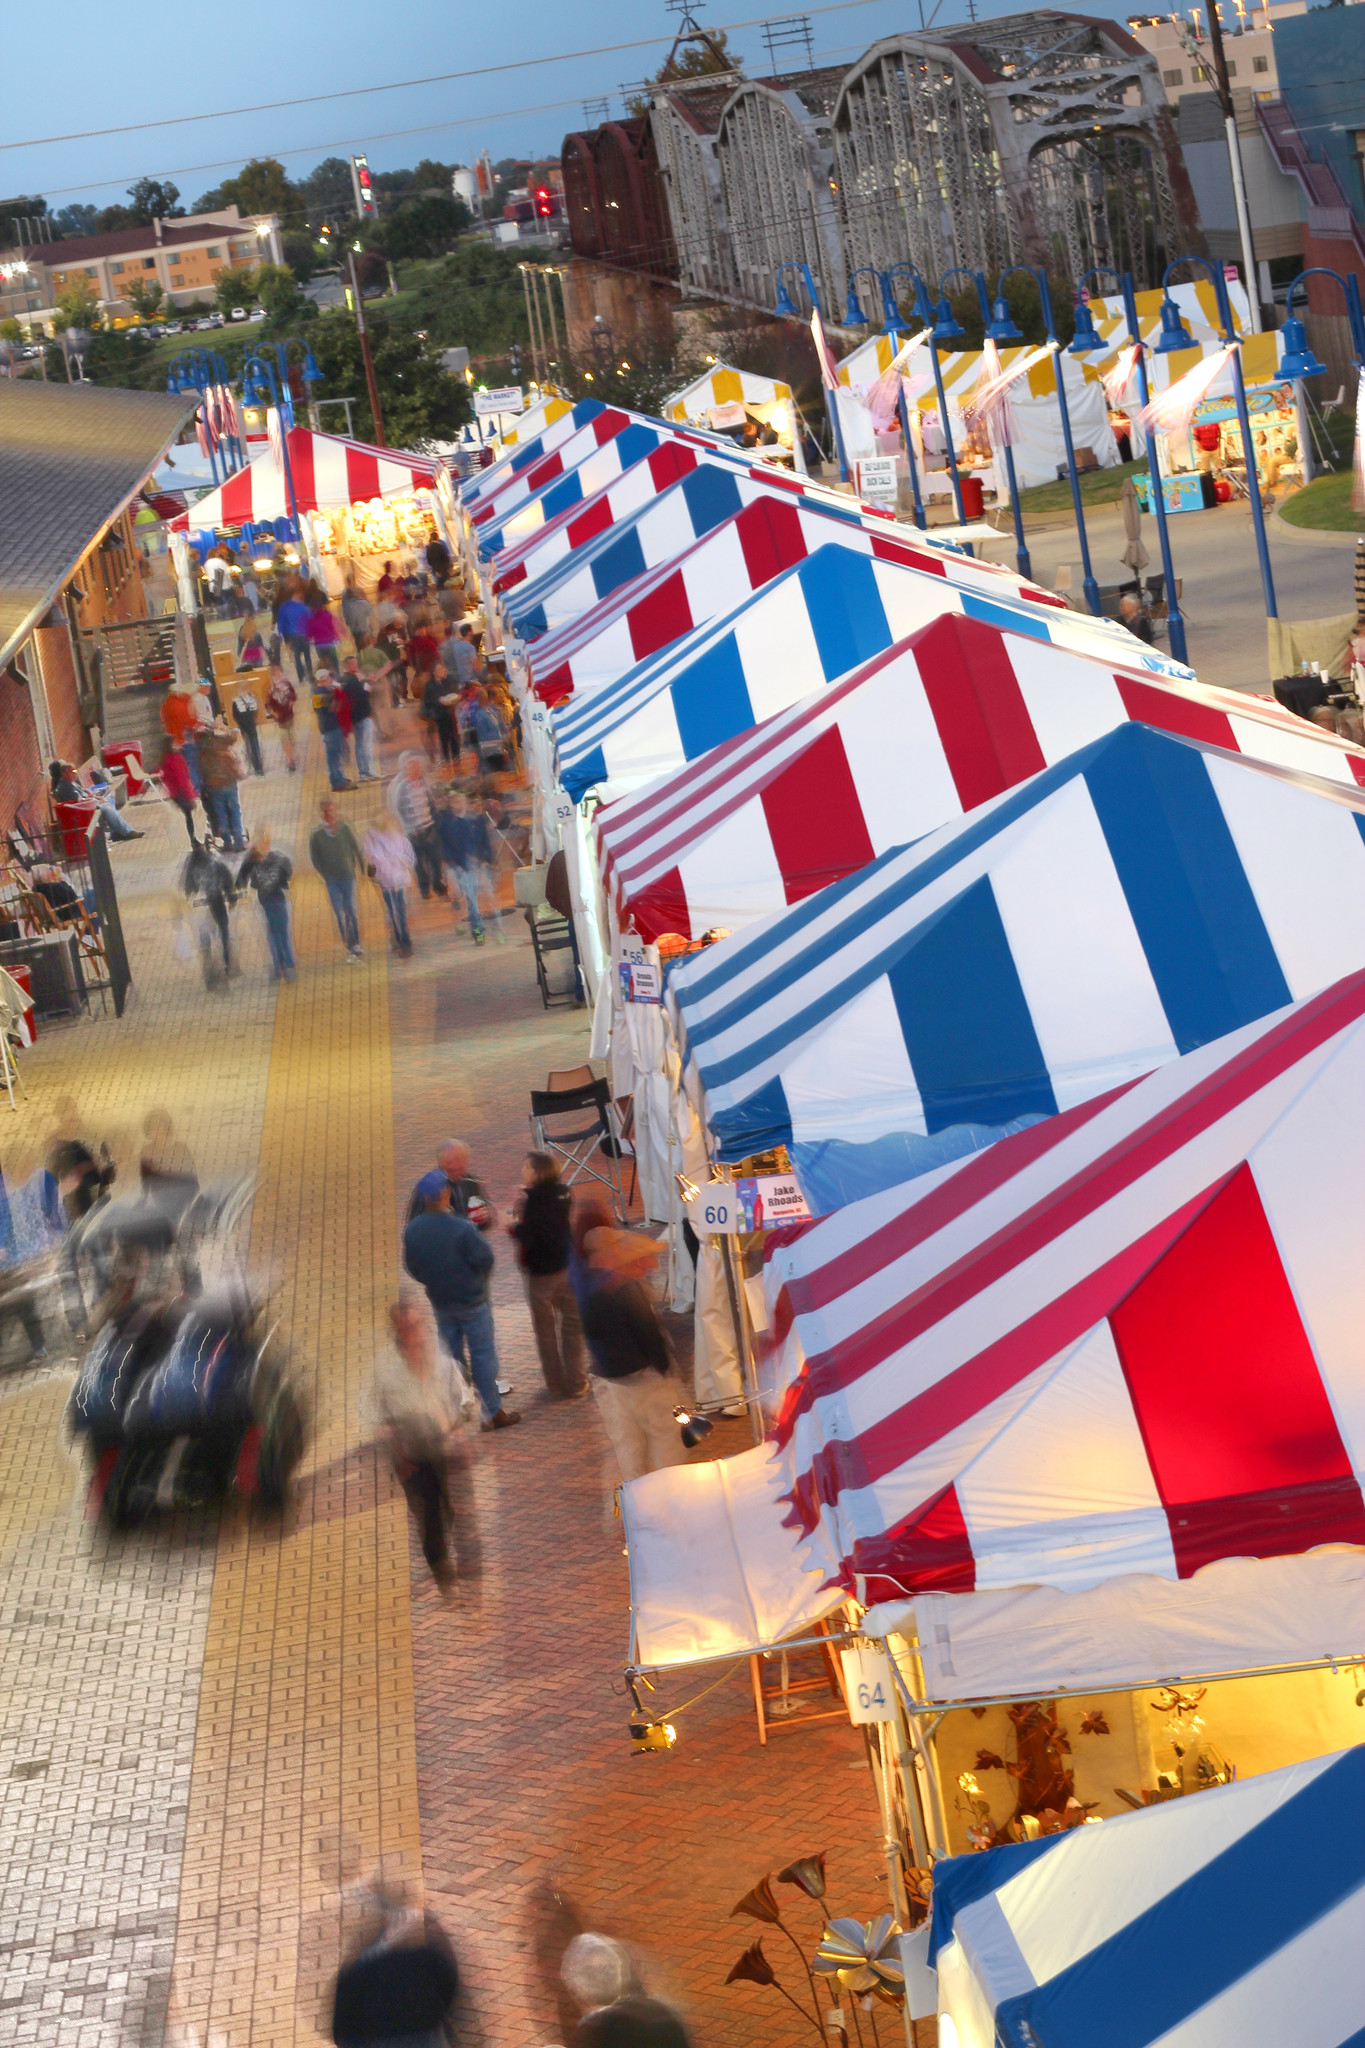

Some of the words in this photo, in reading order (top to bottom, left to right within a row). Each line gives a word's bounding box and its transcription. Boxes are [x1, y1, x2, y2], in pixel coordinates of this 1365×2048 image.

[532, 712, 544, 722] 48
[557, 806, 571, 818] 52
[630, 951, 643, 964] 56
[774, 1186, 795, 1196] Jake
[768, 1194, 803, 1206] Rhoads
[705, 1205, 728, 1224] 60
[857, 1682, 885, 1709] 64
